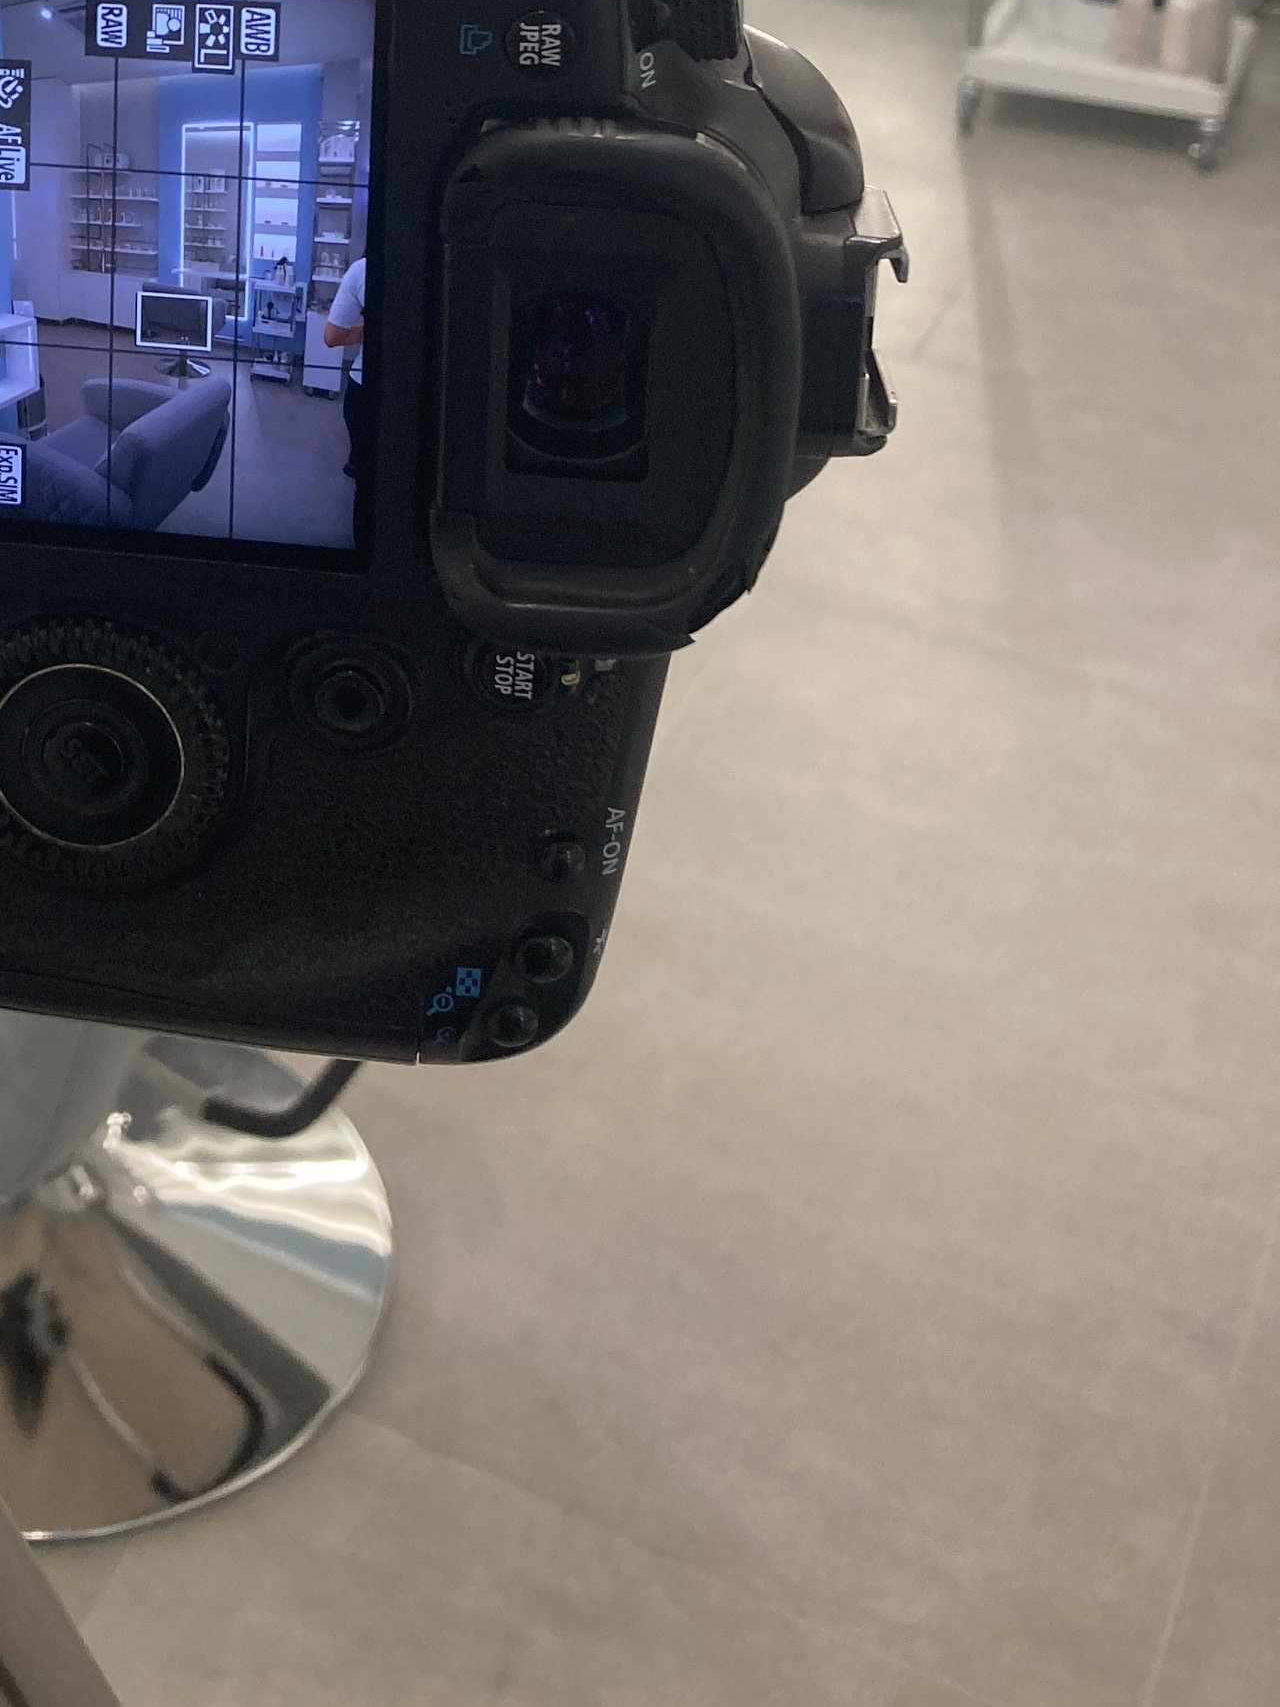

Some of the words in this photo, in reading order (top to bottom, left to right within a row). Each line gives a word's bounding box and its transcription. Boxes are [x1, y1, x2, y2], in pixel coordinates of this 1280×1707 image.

[100, 6, 123, 46] RAW
[245, 9, 272, 53] AWB
[519, 23, 539, 66] JPEG
[541, 24, 562, 67] RAW
[639, 51, 656, 89] ON
[494, 655, 514, 695] STOP
[514, 652, 535, 700] START
[602, 807, 626, 875] AF-ON
